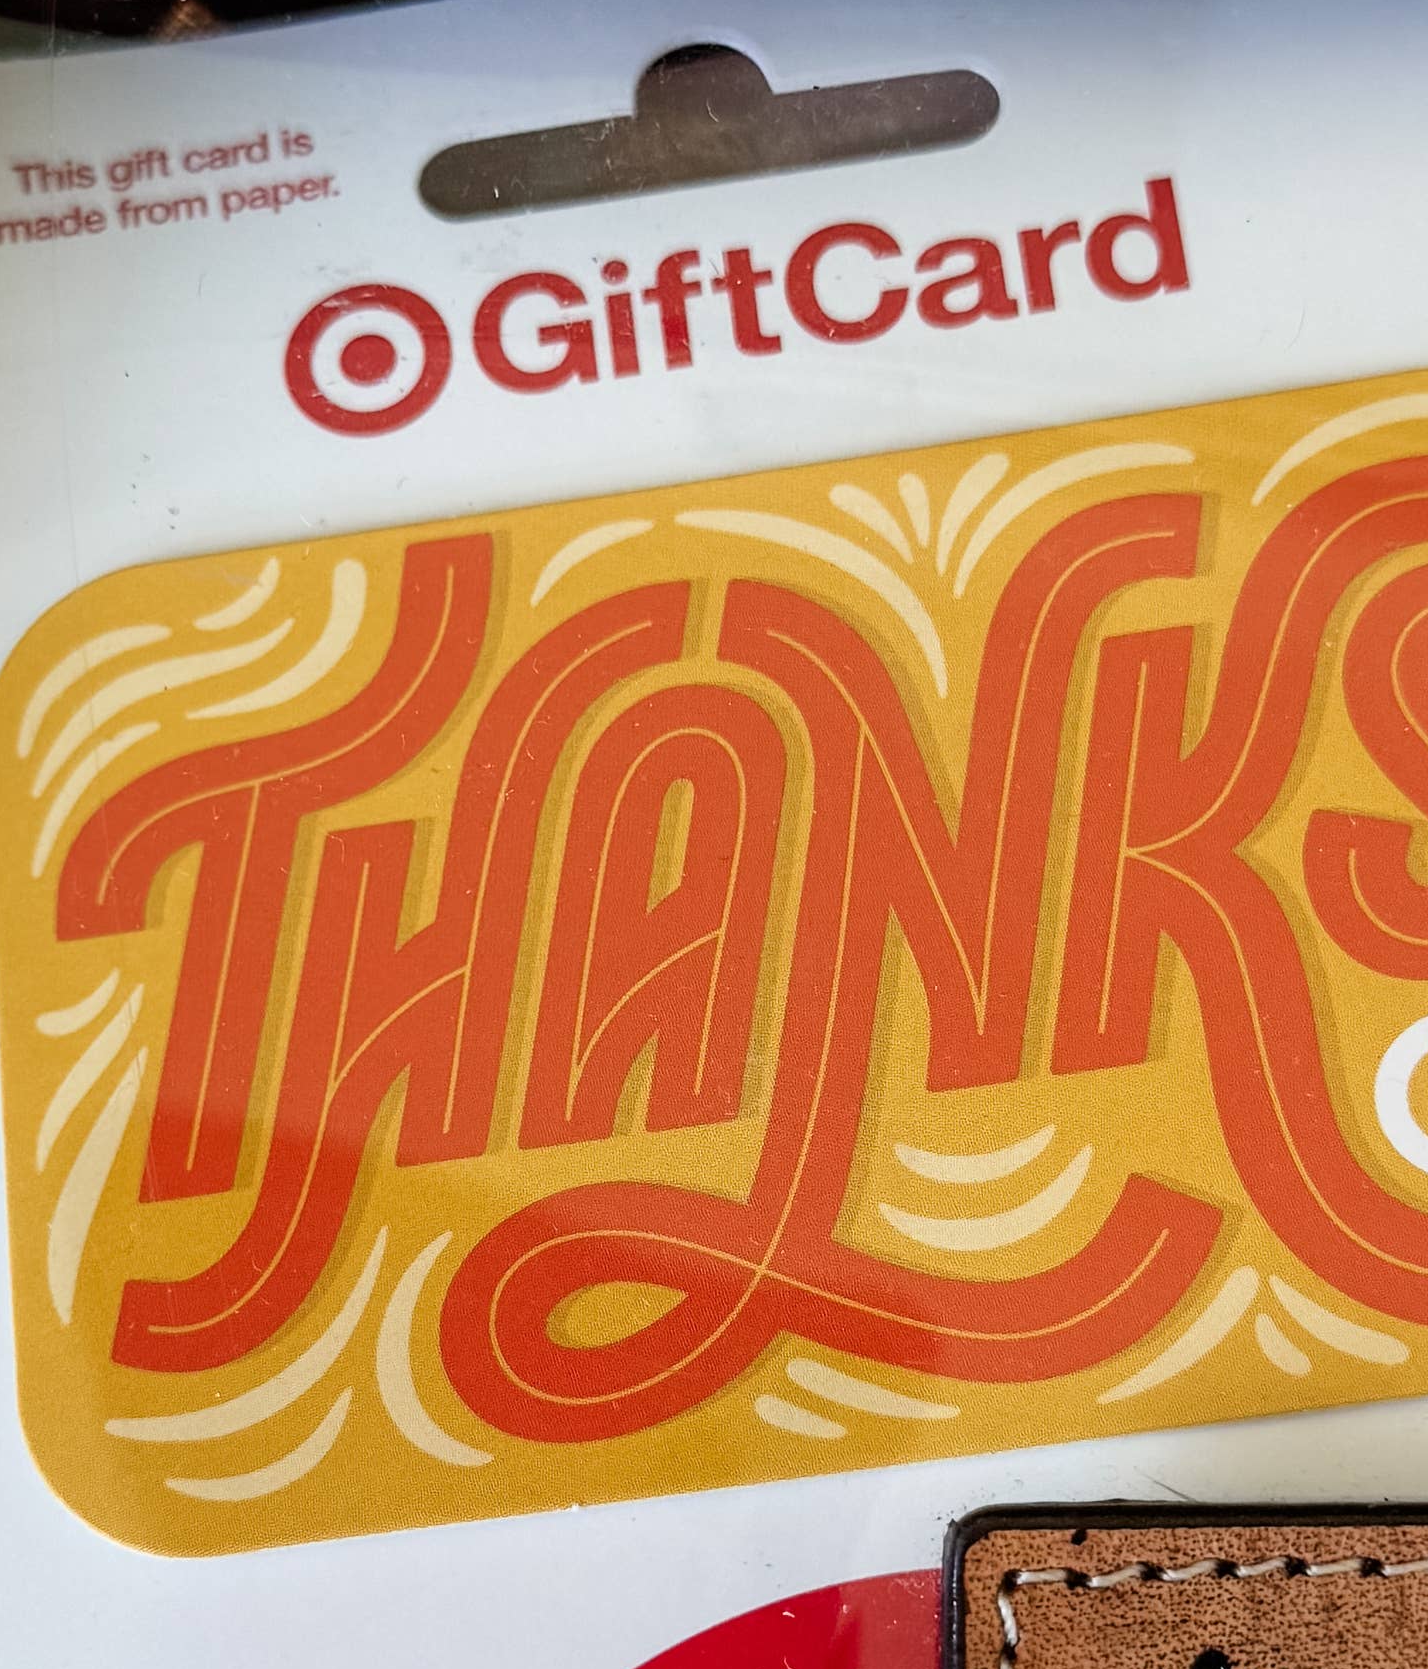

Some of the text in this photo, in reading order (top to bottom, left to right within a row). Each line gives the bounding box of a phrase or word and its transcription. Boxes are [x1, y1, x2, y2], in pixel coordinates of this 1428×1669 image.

[12, 129, 313, 195] This gift card is
[117, 194, 208, 229] from
[220, 175, 340, 221] paper.
[474, 178, 1191, 394] GiftCard
